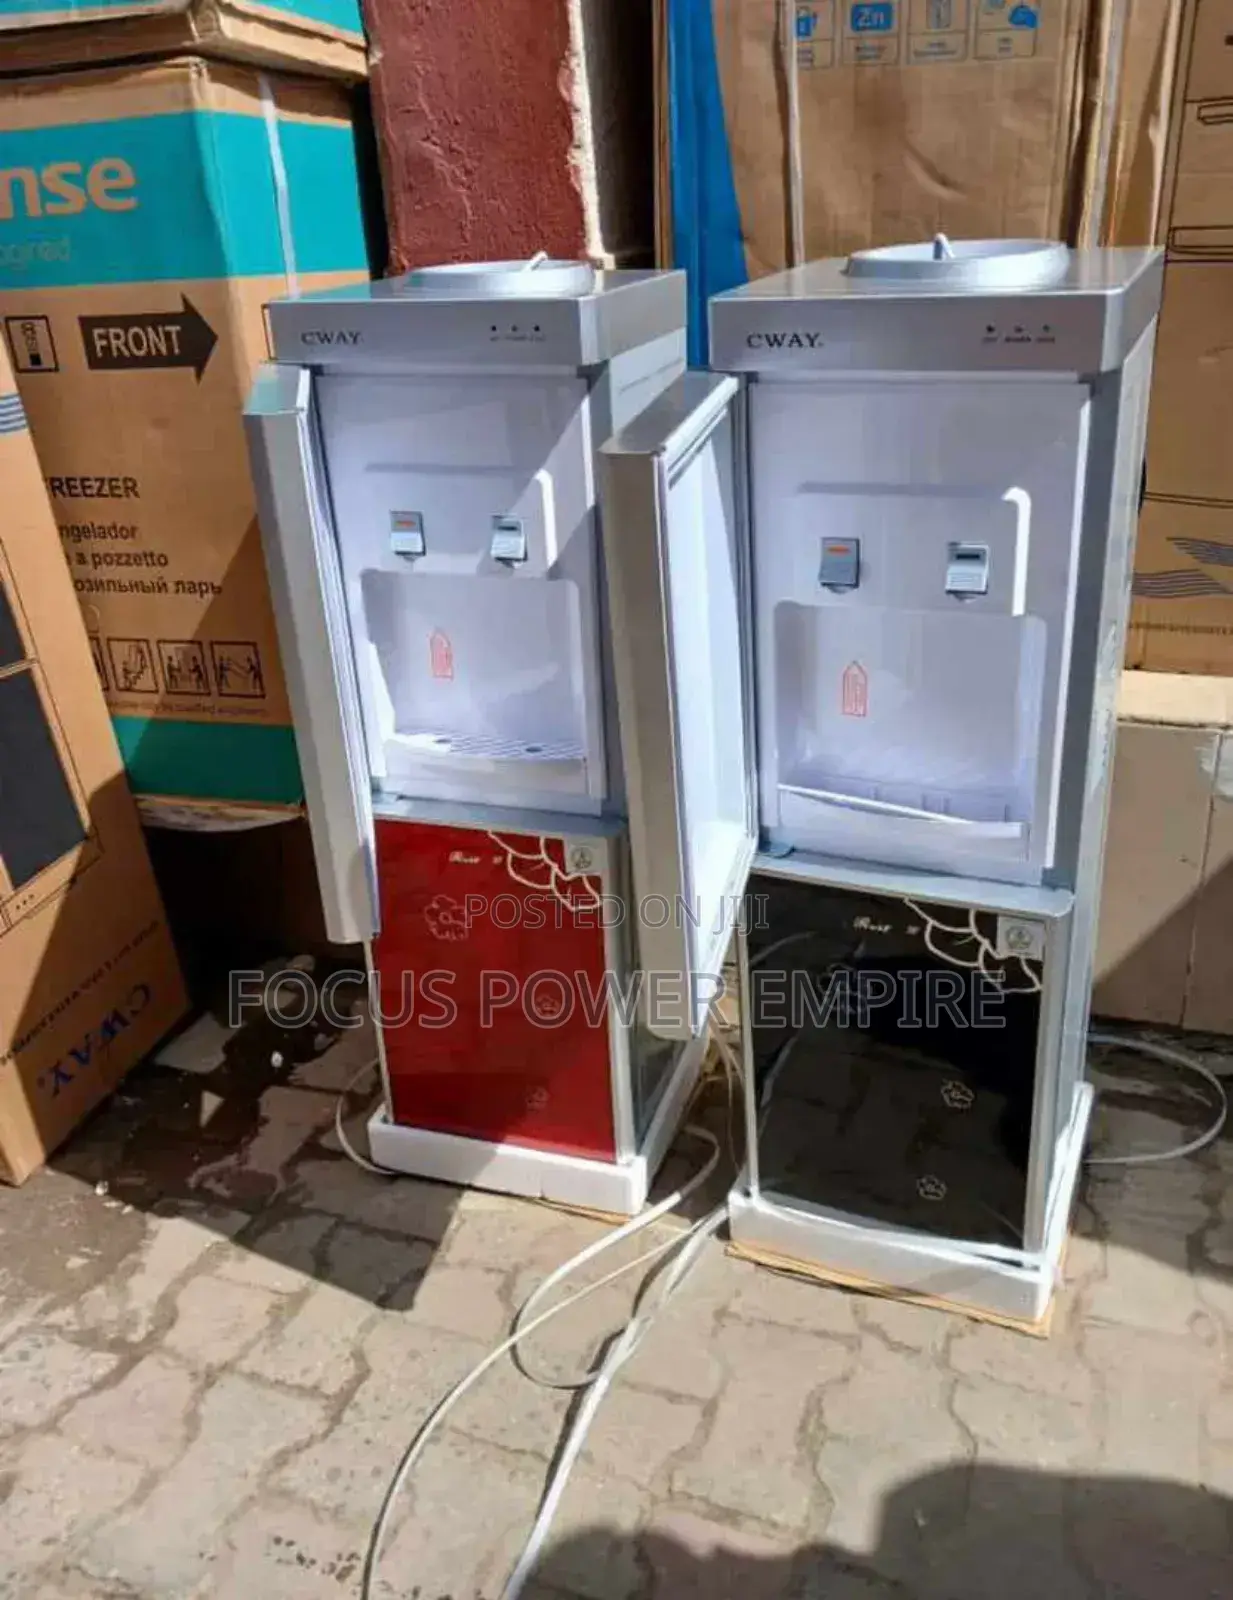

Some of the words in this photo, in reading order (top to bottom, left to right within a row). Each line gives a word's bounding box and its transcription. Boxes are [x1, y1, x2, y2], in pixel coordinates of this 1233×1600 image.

[857, 8, 885, 28] Zn
[0, 157, 137, 219] nse
[92, 325, 182, 358] FRONT
[59, 521, 138, 544] ngelador
[91, 550, 168, 570] pozzetto
